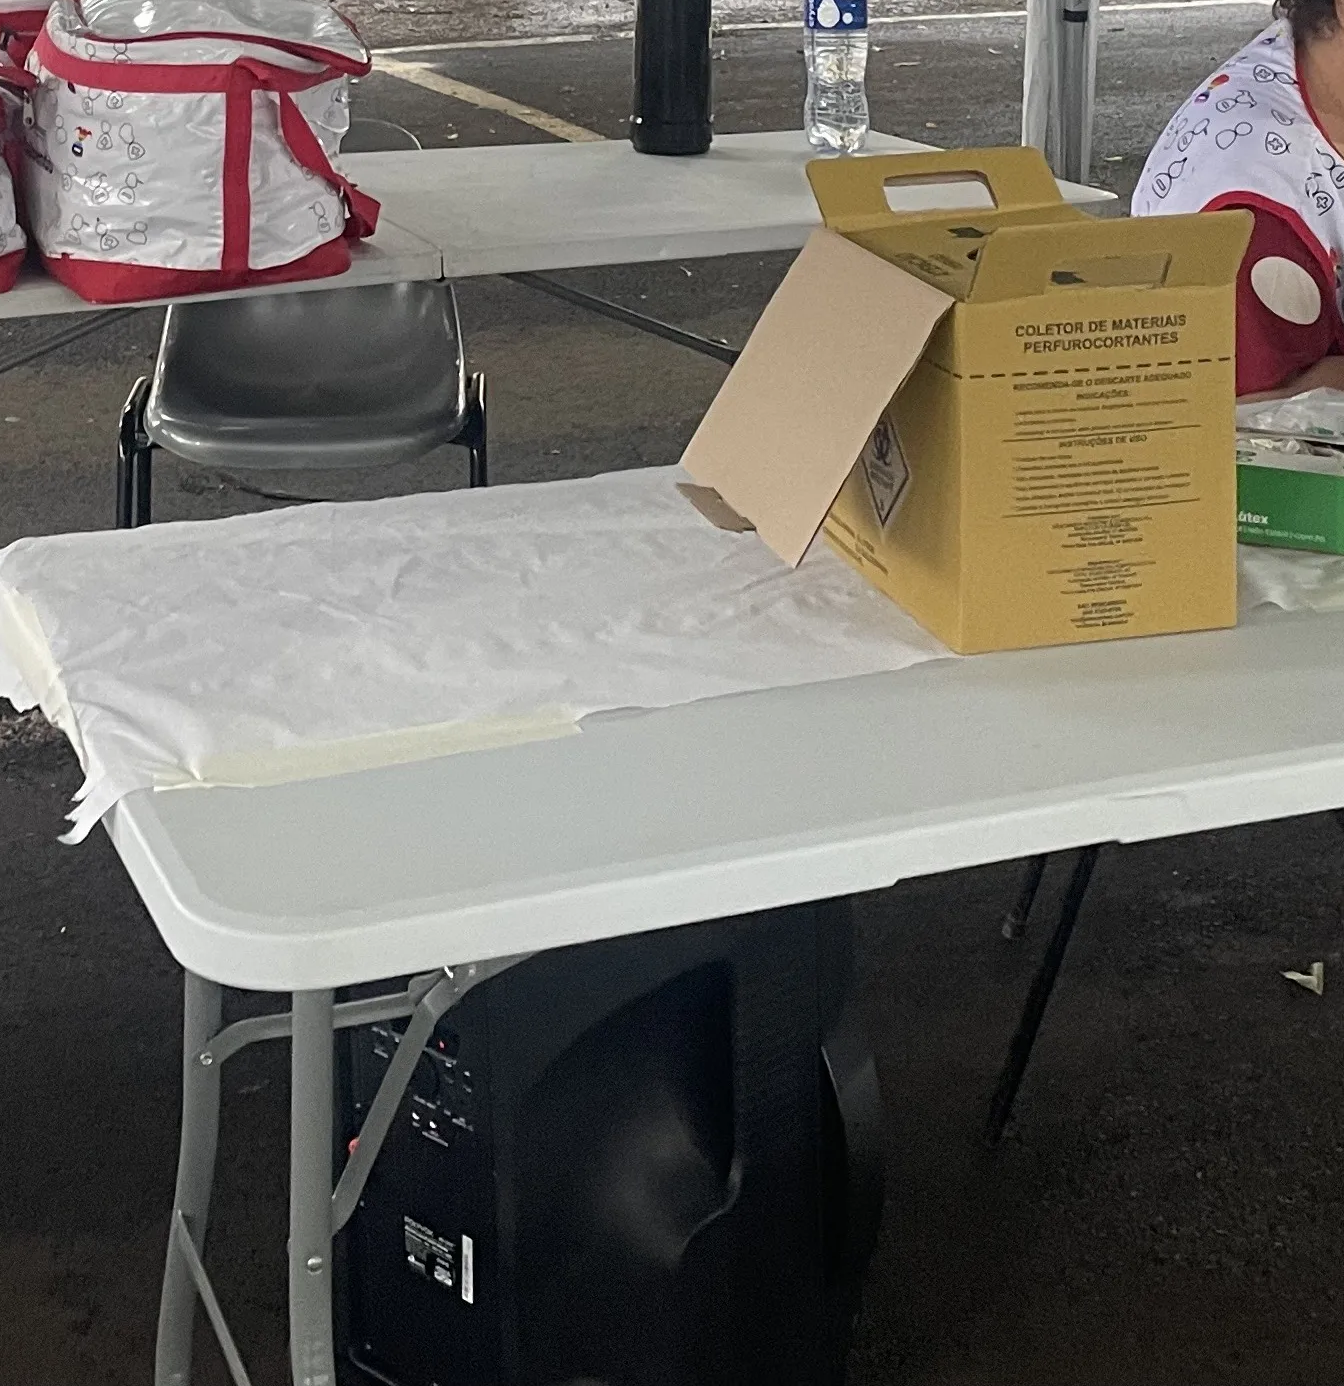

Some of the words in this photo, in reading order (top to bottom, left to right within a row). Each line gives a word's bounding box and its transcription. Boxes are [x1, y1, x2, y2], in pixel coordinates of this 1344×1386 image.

[1015, 321, 1084, 337] COLETOR
[1088, 319, 1108, 333] DE
[1112, 314, 1187, 331] MATERIAIS
[1023, 331, 1179, 354] PERFUROCORTANTES
[1238, 510, 1268, 525] átex
